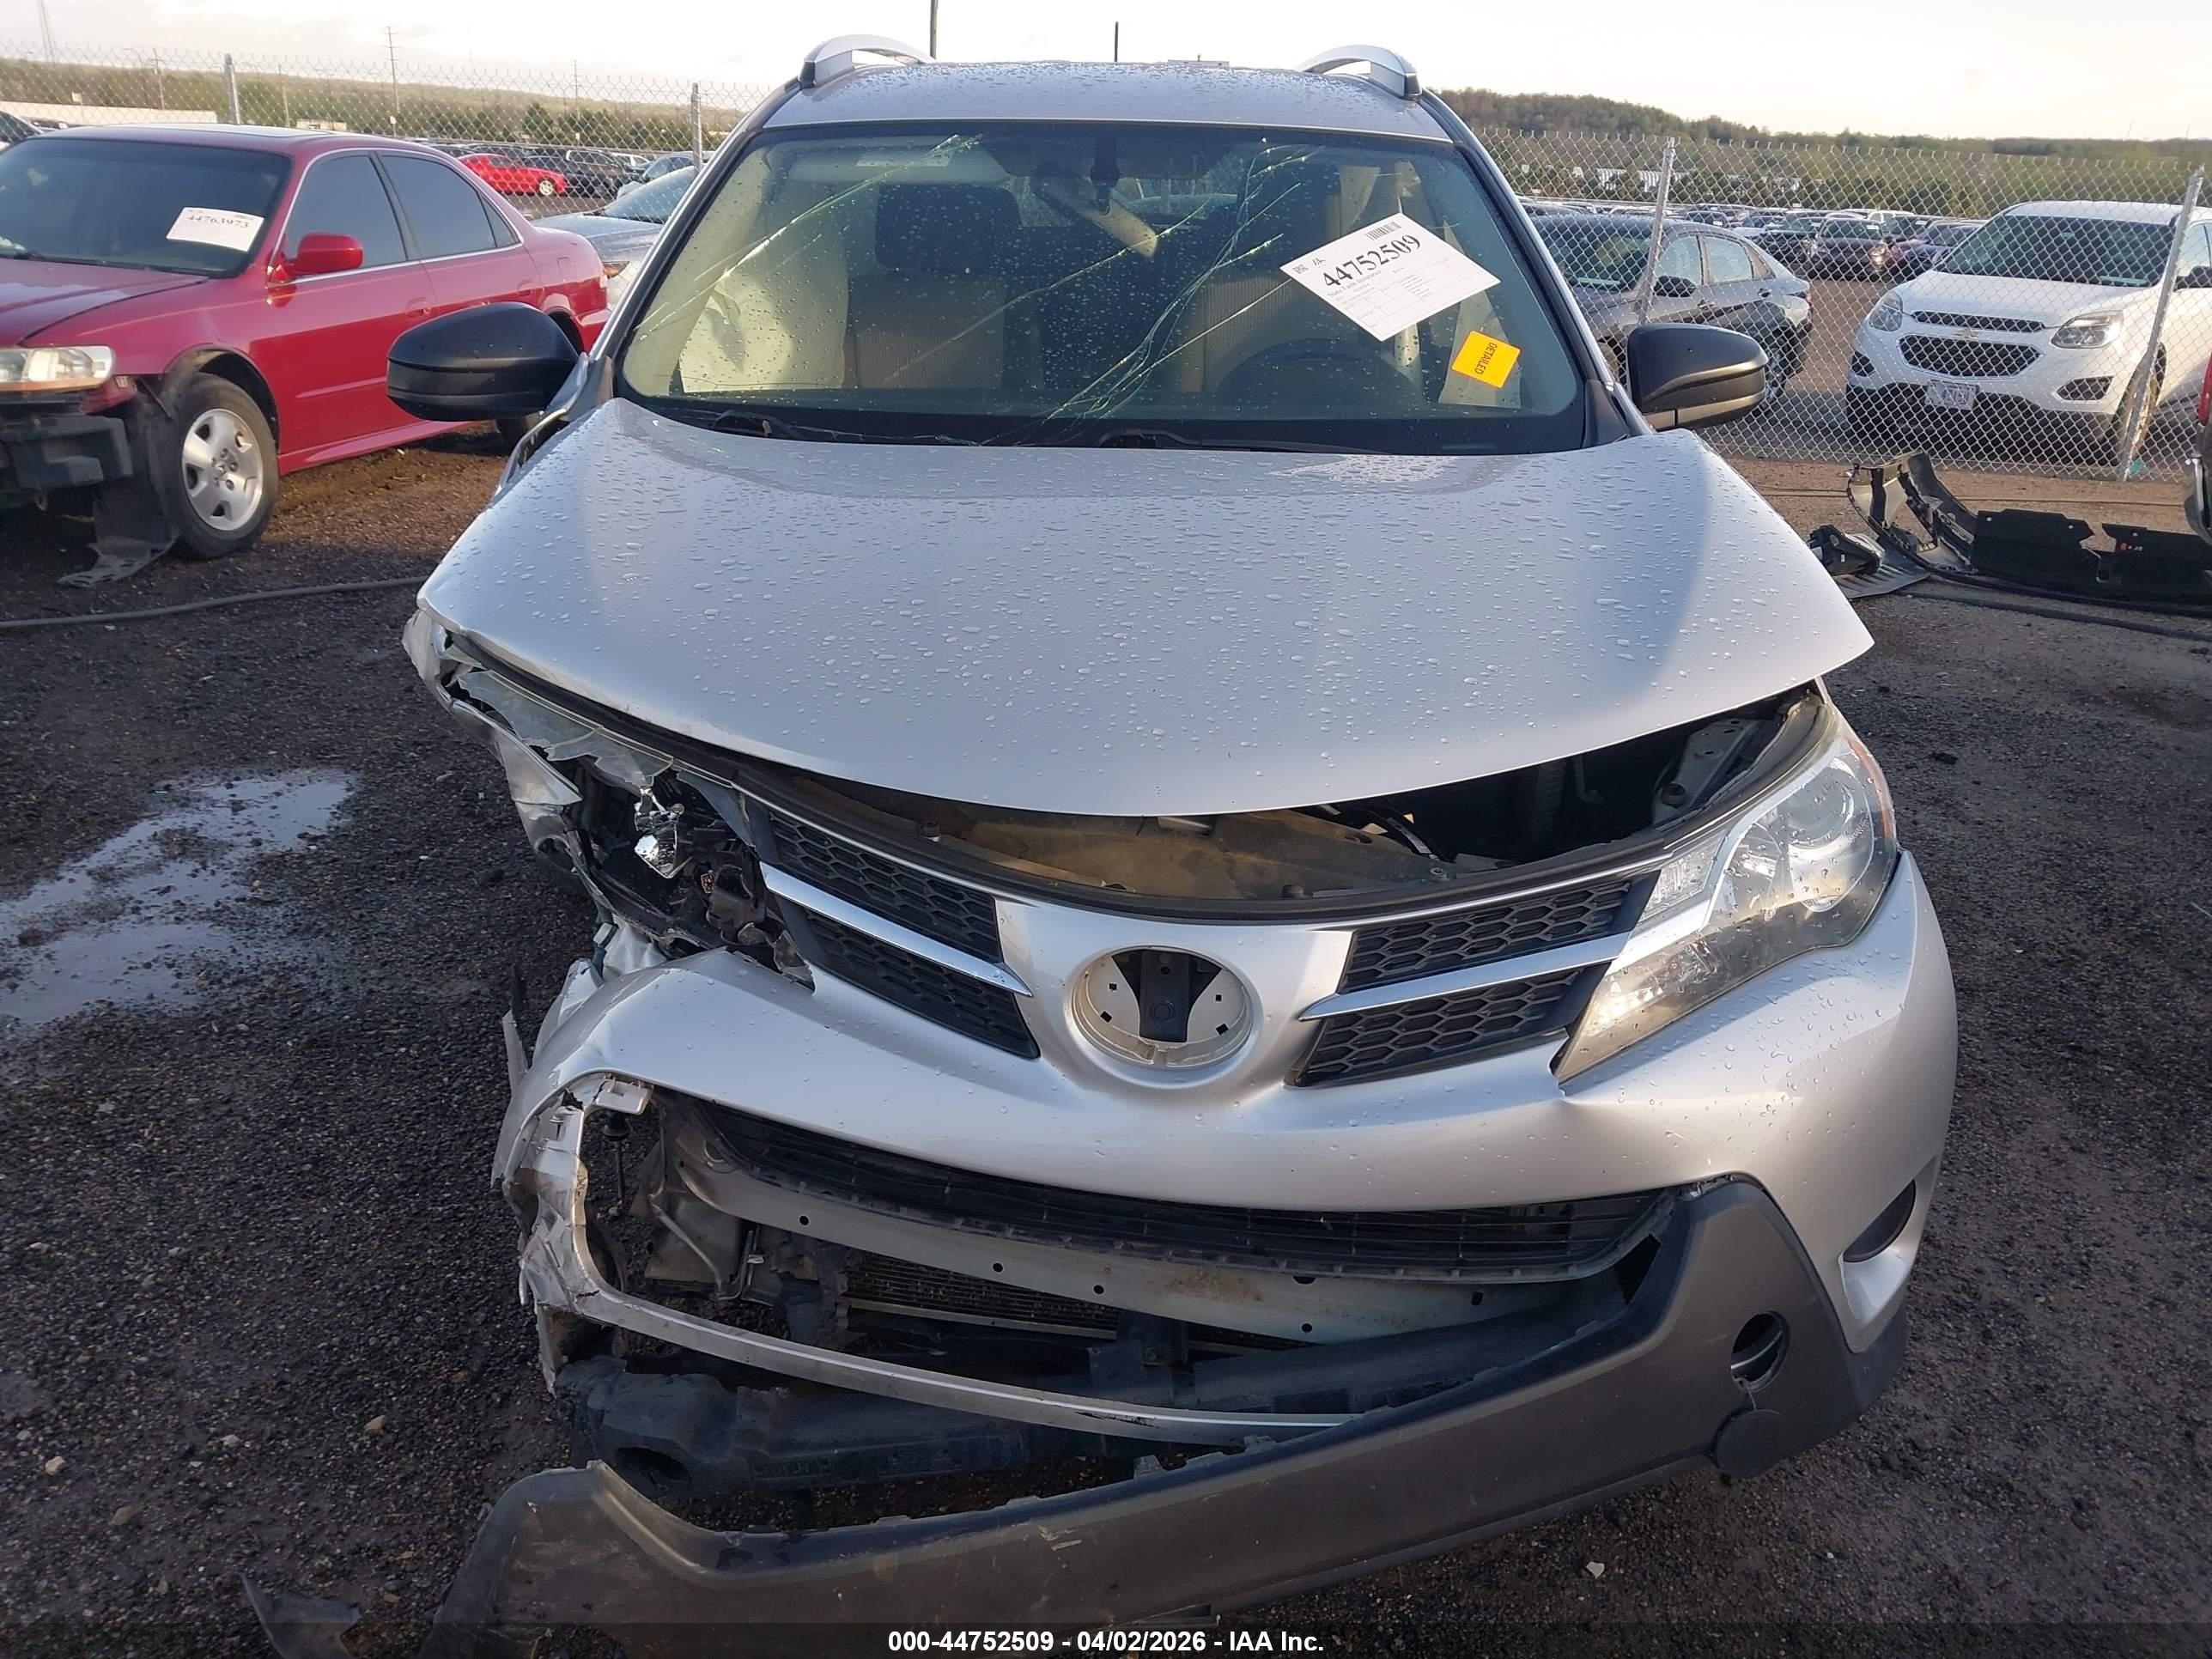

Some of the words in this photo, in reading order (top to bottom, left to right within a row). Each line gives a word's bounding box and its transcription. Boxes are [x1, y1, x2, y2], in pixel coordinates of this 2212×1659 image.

[187, 214, 250, 228] 44763973
[1322, 234, 1421, 287] 44752509
[1474, 342, 1498, 375] DETAILED
